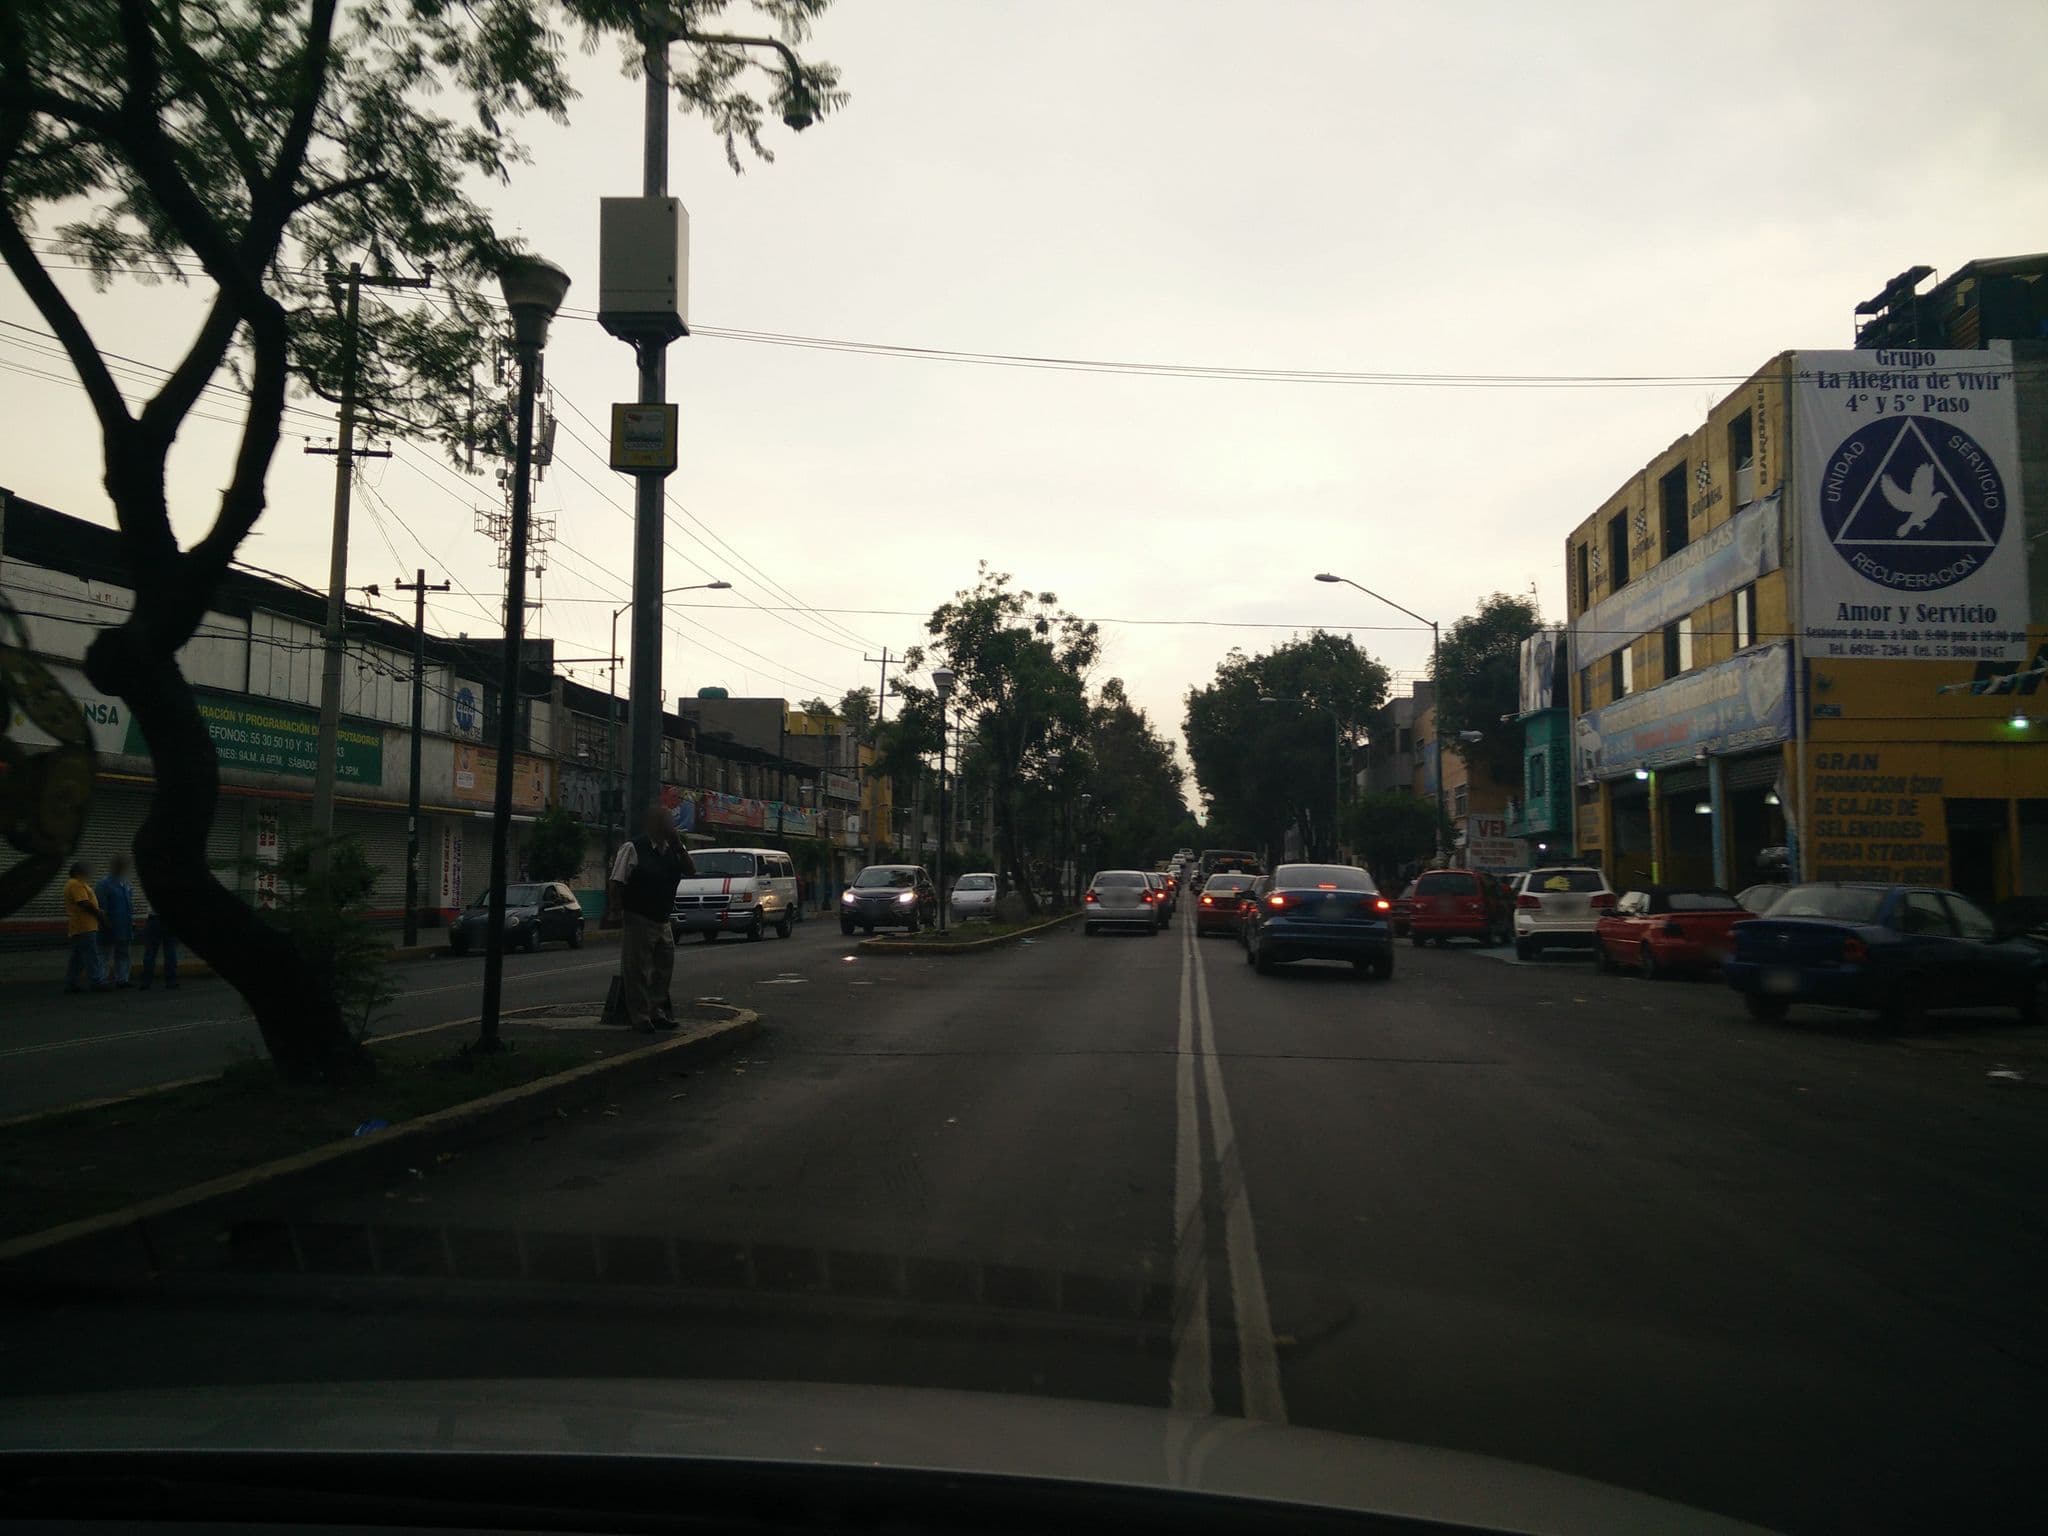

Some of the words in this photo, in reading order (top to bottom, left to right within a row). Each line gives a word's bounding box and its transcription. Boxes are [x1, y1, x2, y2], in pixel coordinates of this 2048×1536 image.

[1875, 349, 1936, 369] Grupo
[1926, 371, 1949, 390] de
[1845, 394, 1868, 412] 4°
[1876, 396, 1887, 414] y
[1893, 394, 1915, 412] 5°
[1922, 394, 1970, 413] Paso
[1828, 440, 1864, 502] UNIDAD
[1947, 434, 2000, 509] SERVICIO
[1851, 551, 1978, 588] RECUPERACION
[1837, 603, 1891, 621] Amor
[1899, 606, 1911, 624] y
[1917, 603, 1996, 623] Servicio
[238, 711, 244, 723] Y
[246, 713, 311, 735] PROGRAMACIÓN
[296, 739, 302, 751] Y
[1815, 753, 1878, 769] GRAN
[1815, 798, 1832, 815] DE
[1838, 798, 1893, 816] CAJAS
[1897, 798, 1920, 816] DE
